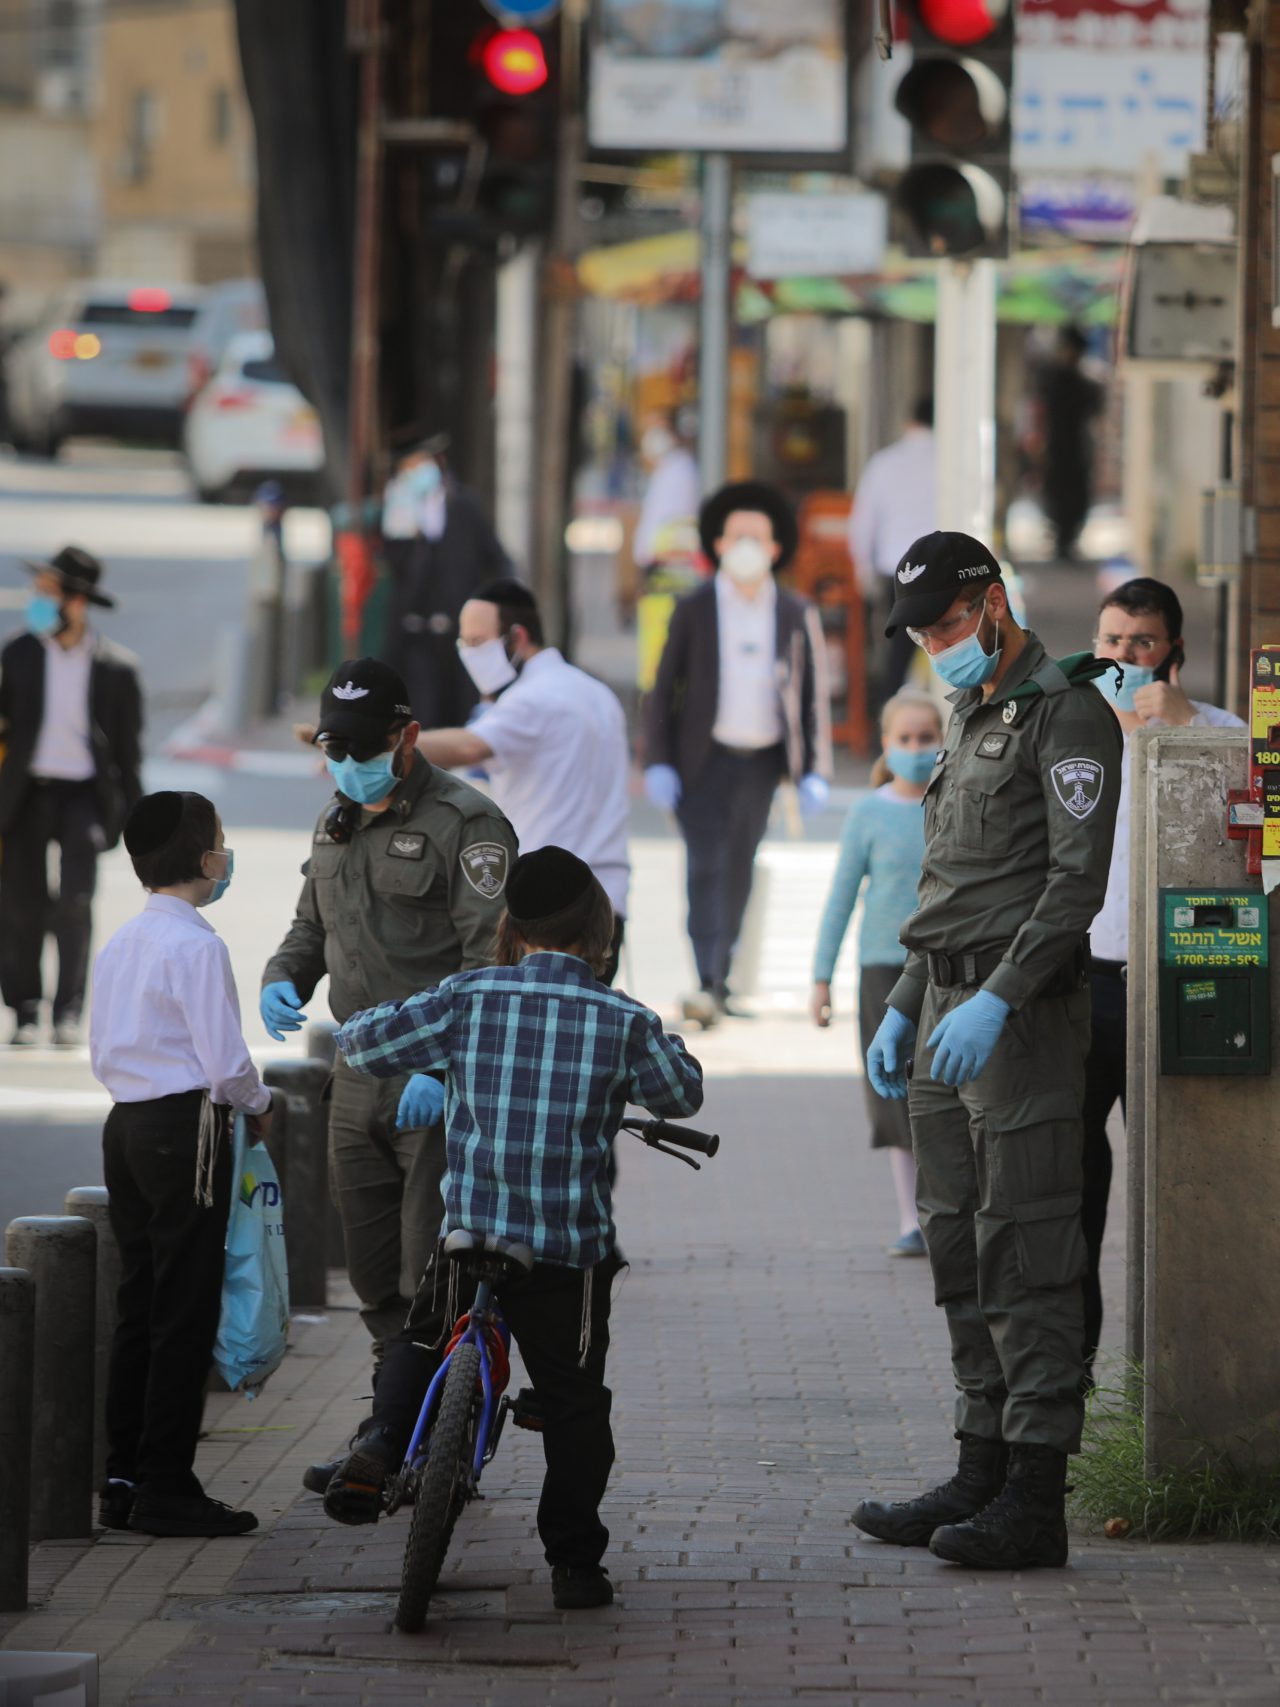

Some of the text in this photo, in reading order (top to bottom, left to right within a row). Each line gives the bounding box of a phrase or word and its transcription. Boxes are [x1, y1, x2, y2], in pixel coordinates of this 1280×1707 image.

[957, 564, 990, 580] משטרה
[1185, 897, 1216, 906] החסד
[1169, 929, 1262, 946] אשל התמר
